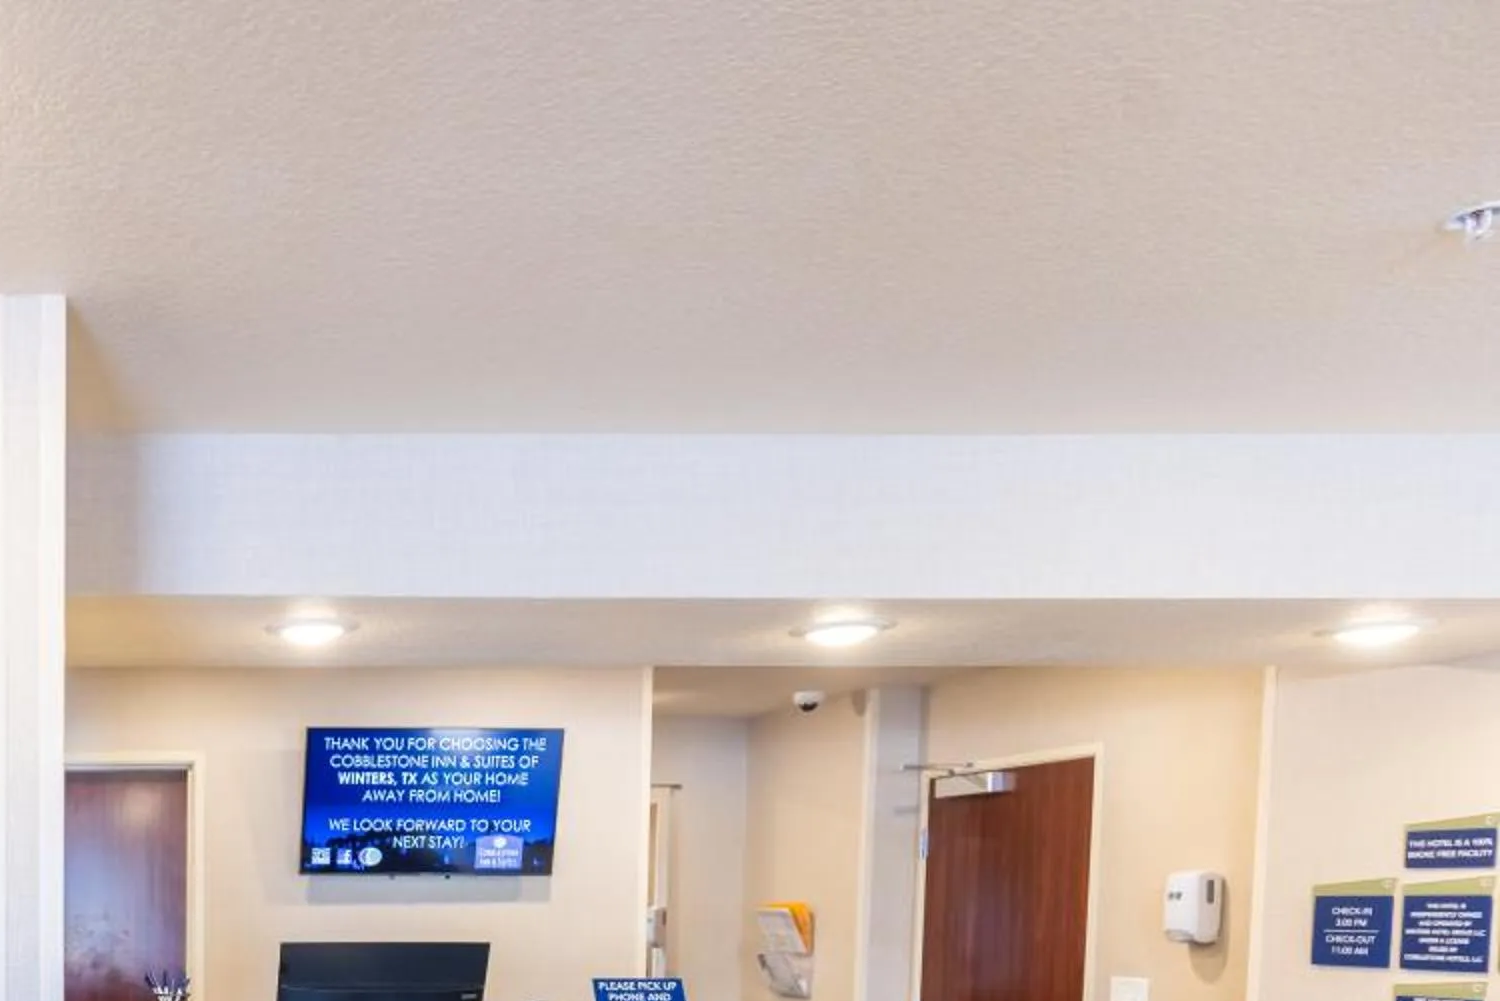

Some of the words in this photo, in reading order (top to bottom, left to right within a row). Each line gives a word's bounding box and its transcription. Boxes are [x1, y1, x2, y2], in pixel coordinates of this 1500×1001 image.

[324, 737, 370, 751] THANK
[374, 737, 404, 751] YOU
[407, 737, 435, 751] FOR
[440, 737, 519, 751] CHOOSING
[523, 737, 547, 751] THE
[329, 755, 428, 769] COBBLESTONE
[431, 755, 457, 769] INN
[461, 755, 472, 769] &
[474, 755, 515, 769] SUITES
[518, 755, 540, 769] OF
[338, 772, 398, 786] WINTERS,
[401, 772, 418, 786] TX
[421, 772, 438, 786] AS
[443, 772, 482, 786] YOUR
[485, 772, 529, 786] HOME
[362, 789, 405, 803] AWAY
[409, 789, 450, 803] FROM
[453, 789, 501, 803] HOME!
[329, 818, 350, 832] WE
[353, 818, 393, 832] LOOK
[396, 818, 466, 832] FORWARD
[469, 818, 488, 832] TO
[490, 818, 531, 832] YOUR
[393, 836, 425, 849] NEXT
[598, 982, 636, 991] PLEASE
[638, 982, 662, 991] PICK
[663, 982, 677, 991] UP
[608, 993, 646, 1001] PHONE
[647, 993, 672, 1001] AND
